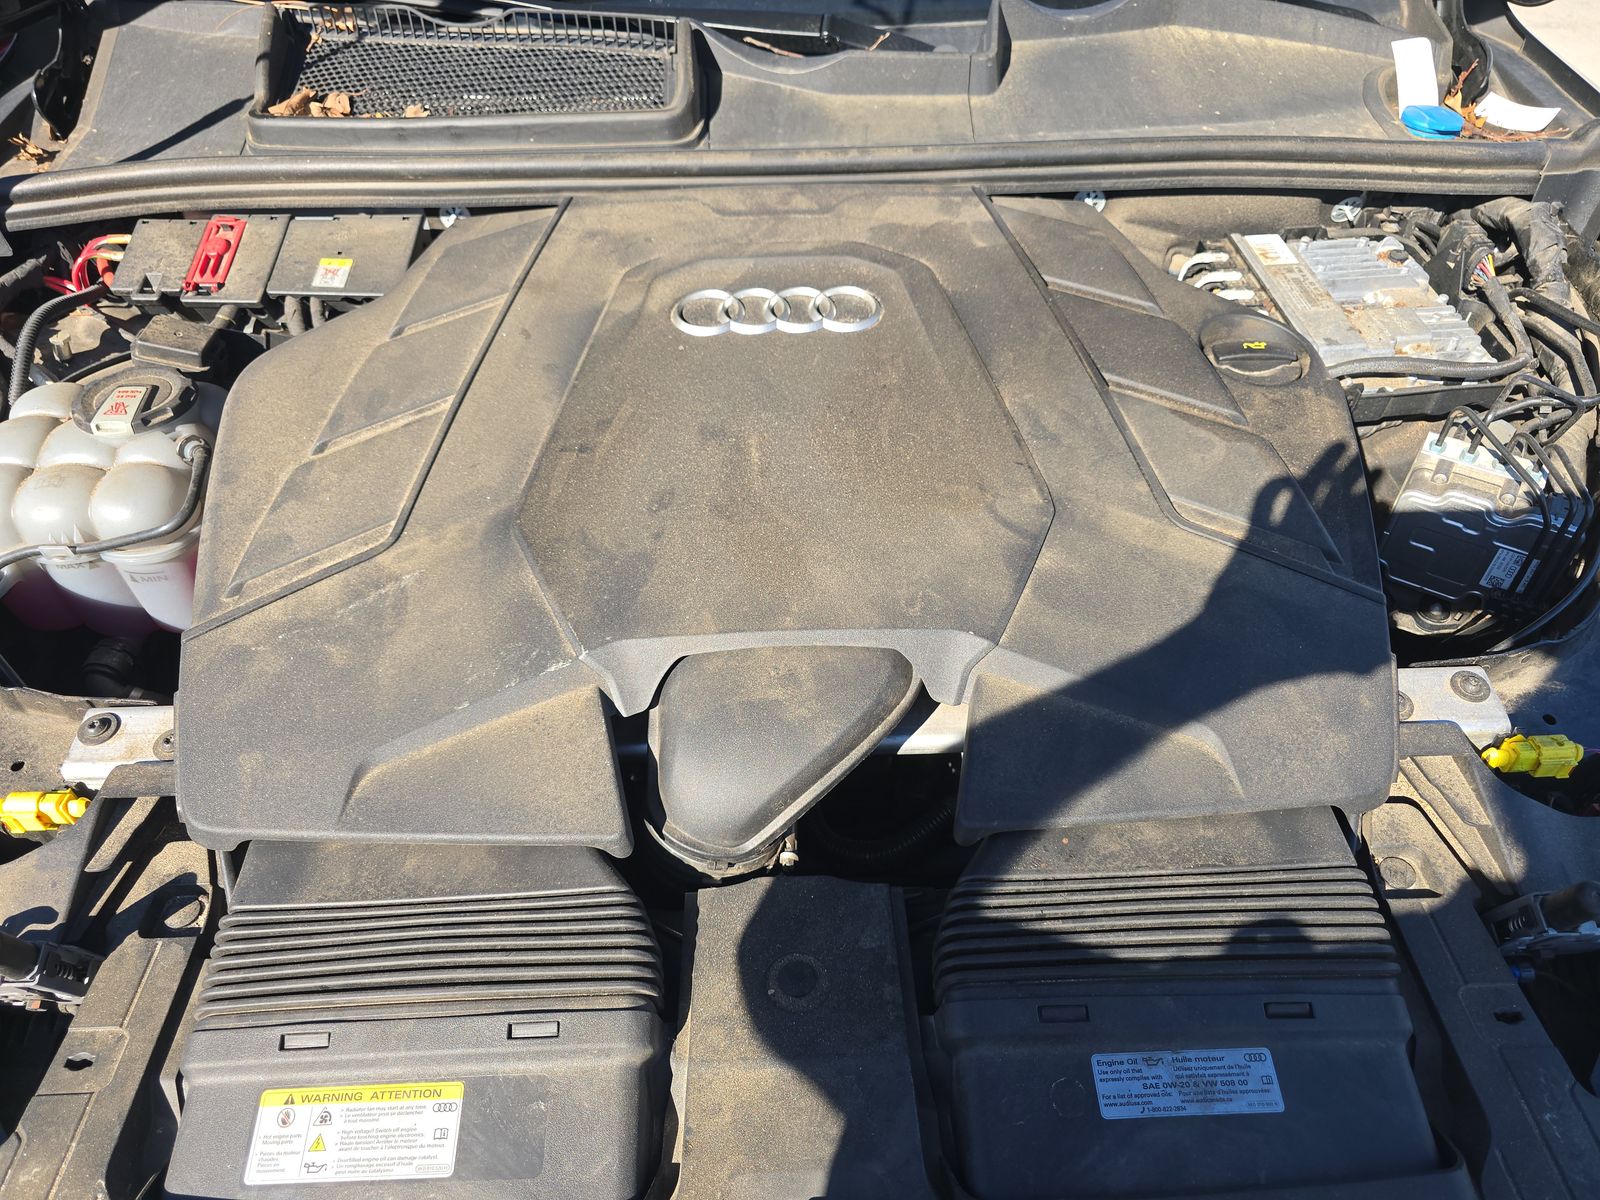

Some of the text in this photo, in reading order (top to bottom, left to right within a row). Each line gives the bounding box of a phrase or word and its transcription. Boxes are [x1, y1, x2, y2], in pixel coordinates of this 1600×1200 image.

[1142, 1082, 1160, 1090] SAE
[1163, 1081, 1190, 1089] 0W-20
[301, 1089, 442, 1104] WARNING ATTENTION
